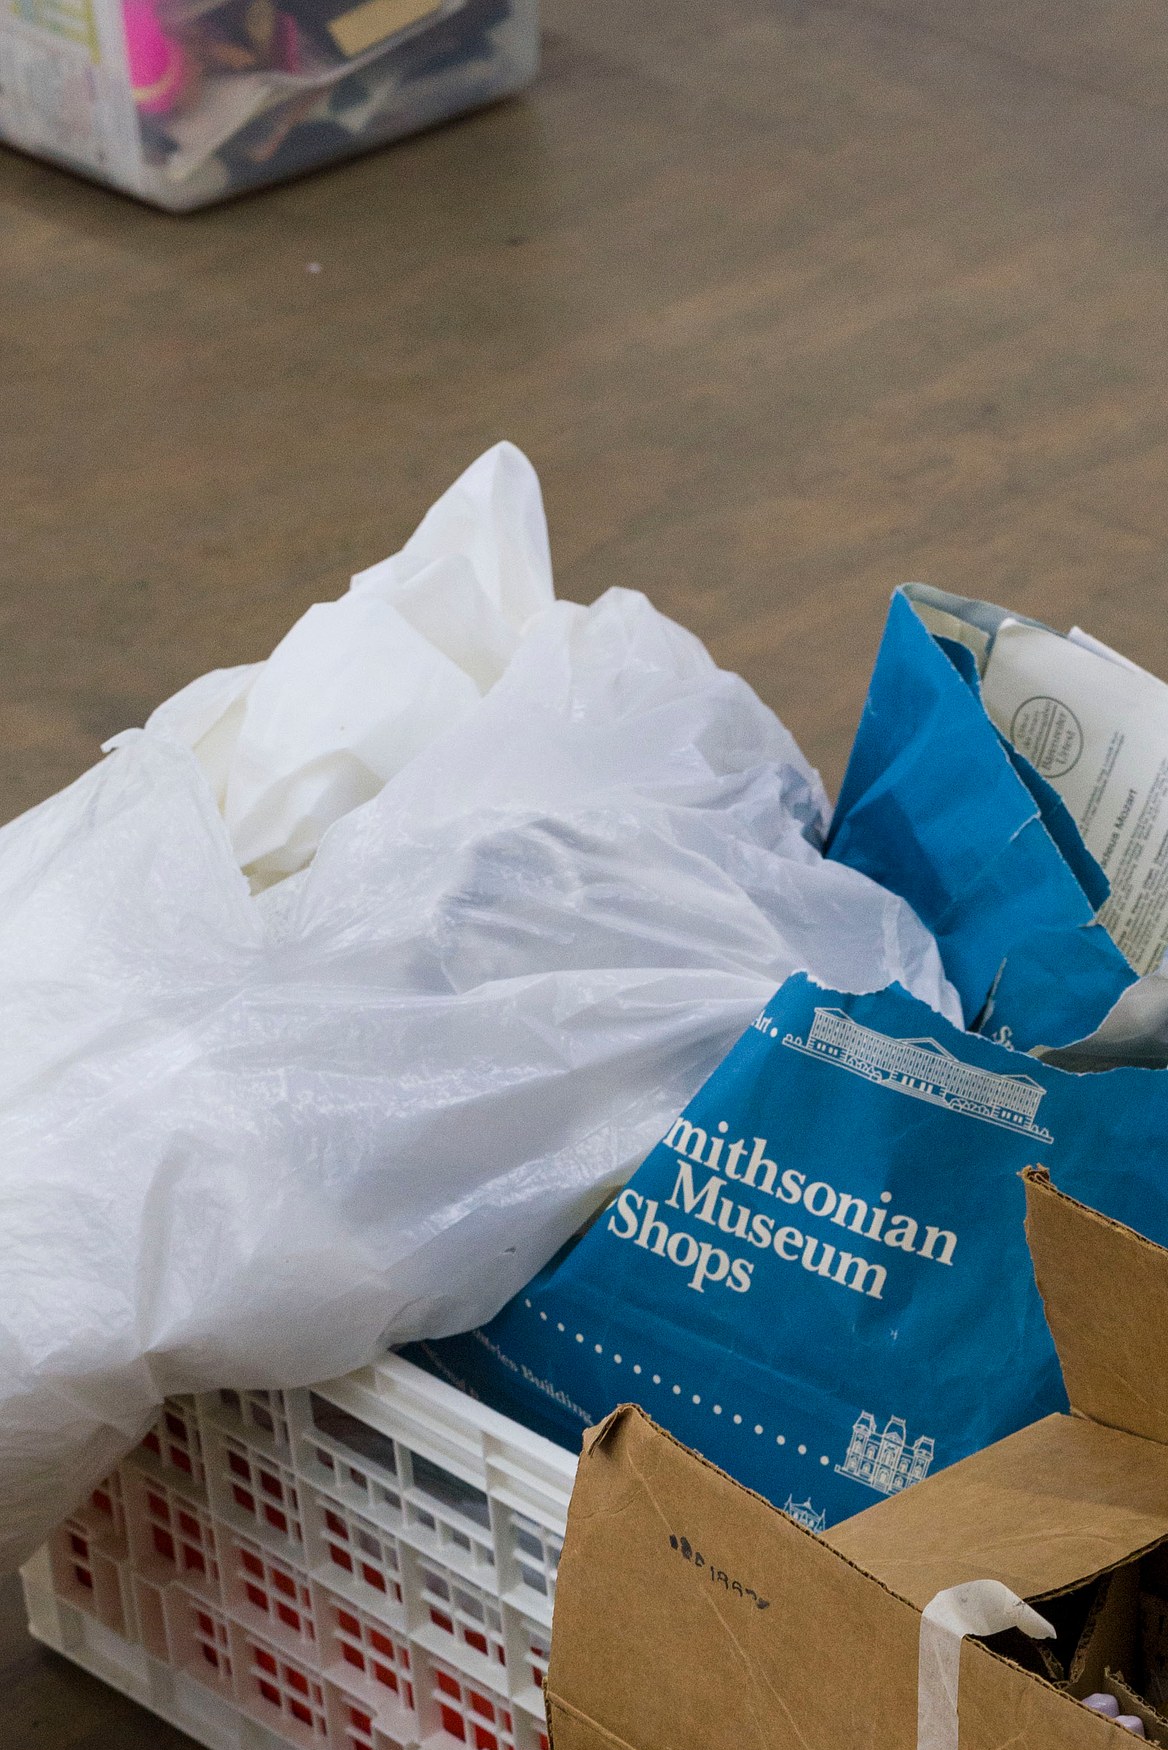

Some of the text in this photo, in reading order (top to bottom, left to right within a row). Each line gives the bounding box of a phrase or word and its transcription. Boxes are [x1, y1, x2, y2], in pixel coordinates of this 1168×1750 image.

[1115, 788, 1139, 831] Mozart
[607, 1188, 756, 1294] Shops
[662, 1115, 958, 1267] mithsonian
[666, 1158, 888, 1300] Museum
